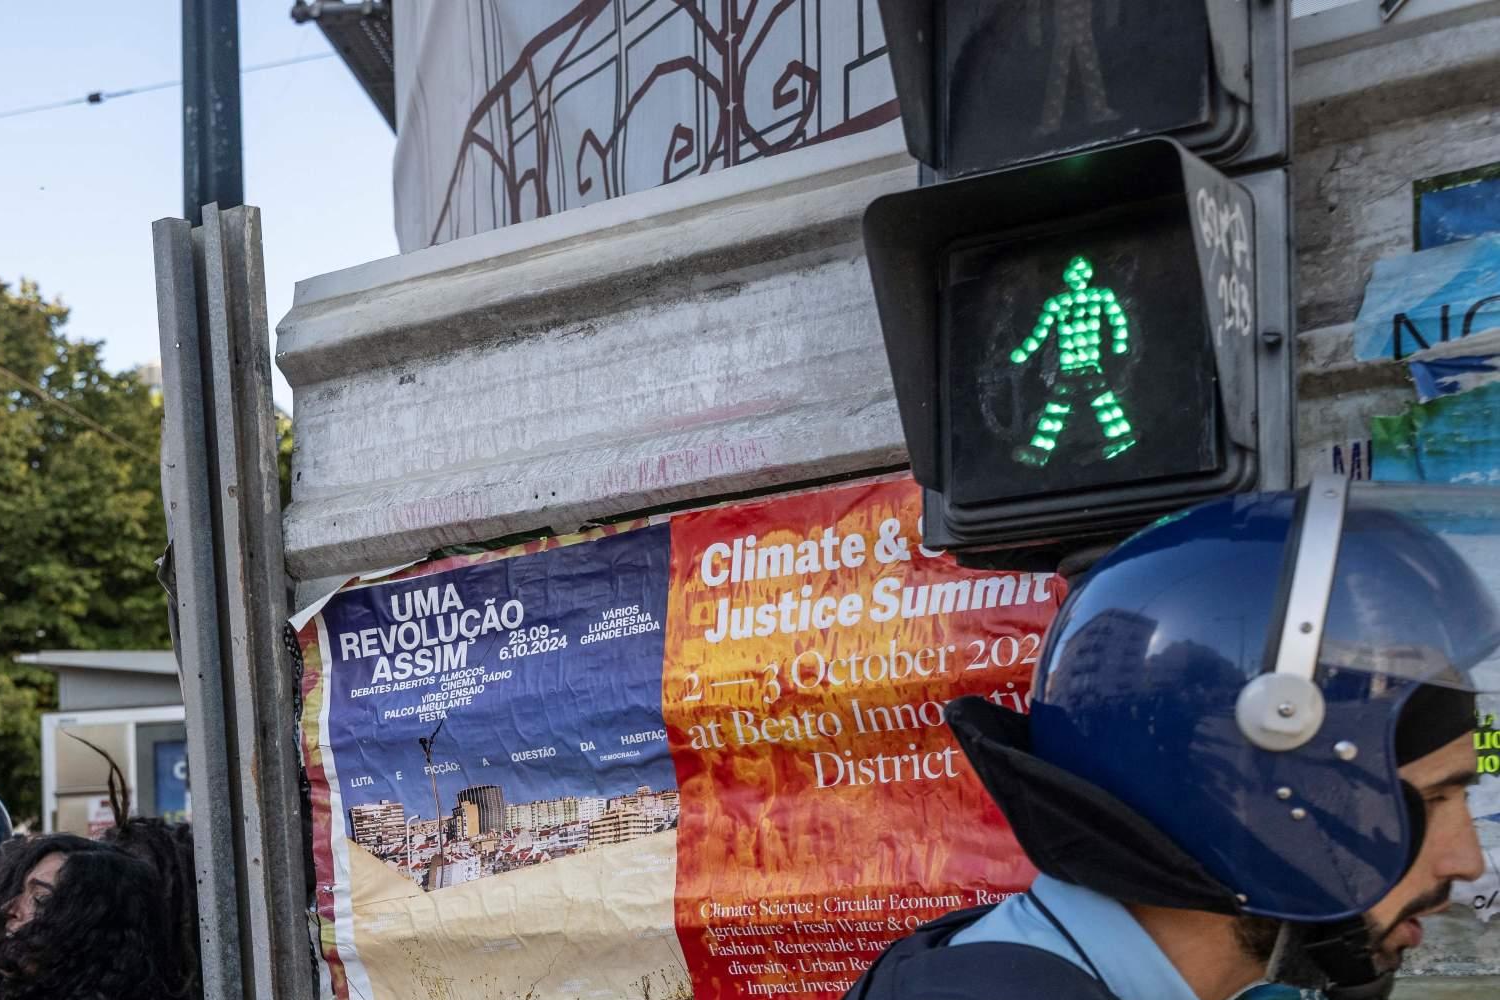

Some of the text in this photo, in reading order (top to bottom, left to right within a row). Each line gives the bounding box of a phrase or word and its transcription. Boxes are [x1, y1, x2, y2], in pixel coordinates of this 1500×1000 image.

[701, 526, 866, 587] Climate
[874, 517, 911, 562] &
[391, 583, 464, 622] UMA
[602, 604, 640, 621] VÁRIOS
[705, 573, 1056, 643] Justice Summit
[340, 597, 525, 661] REVOLUÇÃO
[580, 621, 661, 645] GRANDE LISBOA
[588, 611, 652, 634] LUGARES NA
[499, 634, 568, 661] 6.10.2024
[371, 640, 468, 684] ASSIM
[791, 632, 1041, 690] October 202
[350, 685, 391, 699] DEBATES
[392, 675, 436, 692] ABERTOS
[441, 669, 512, 692] CINEMA RÁDIO
[683, 673, 703, 701] 2
[762, 663, 782, 704] 3
[421, 685, 485, 704] VÍDEO ENSAIO
[384, 696, 472, 719] PALCO AMBULANTE
[419, 711, 448, 723] FESTA
[688, 720, 726, 750] at
[730, 706, 843, 747] Beato
[351, 729, 668, 788] LUTA E FICÇÃO: A QUESTÃO DA HABITAÇ
[600, 750, 641, 762] DEMOCRACIA
[813, 742, 960, 789] District
[700, 900, 754, 919] Climate
[758, 899, 813, 917] Science
[823, 895, 885, 914] Circular
[889, 892, 964, 914] Economy
[705, 919, 784, 941] Agriculture
[794, 918, 834, 935] Fresh
[836, 917, 884, 934] Water
[887, 916, 902, 931] &
[709, 941, 765, 958] Fashion
[772, 939, 855, 957] Renewable
[728, 961, 789, 979] diversity
[799, 958, 846, 974] Urban
[747, 977, 857, 999] Impact Investin
